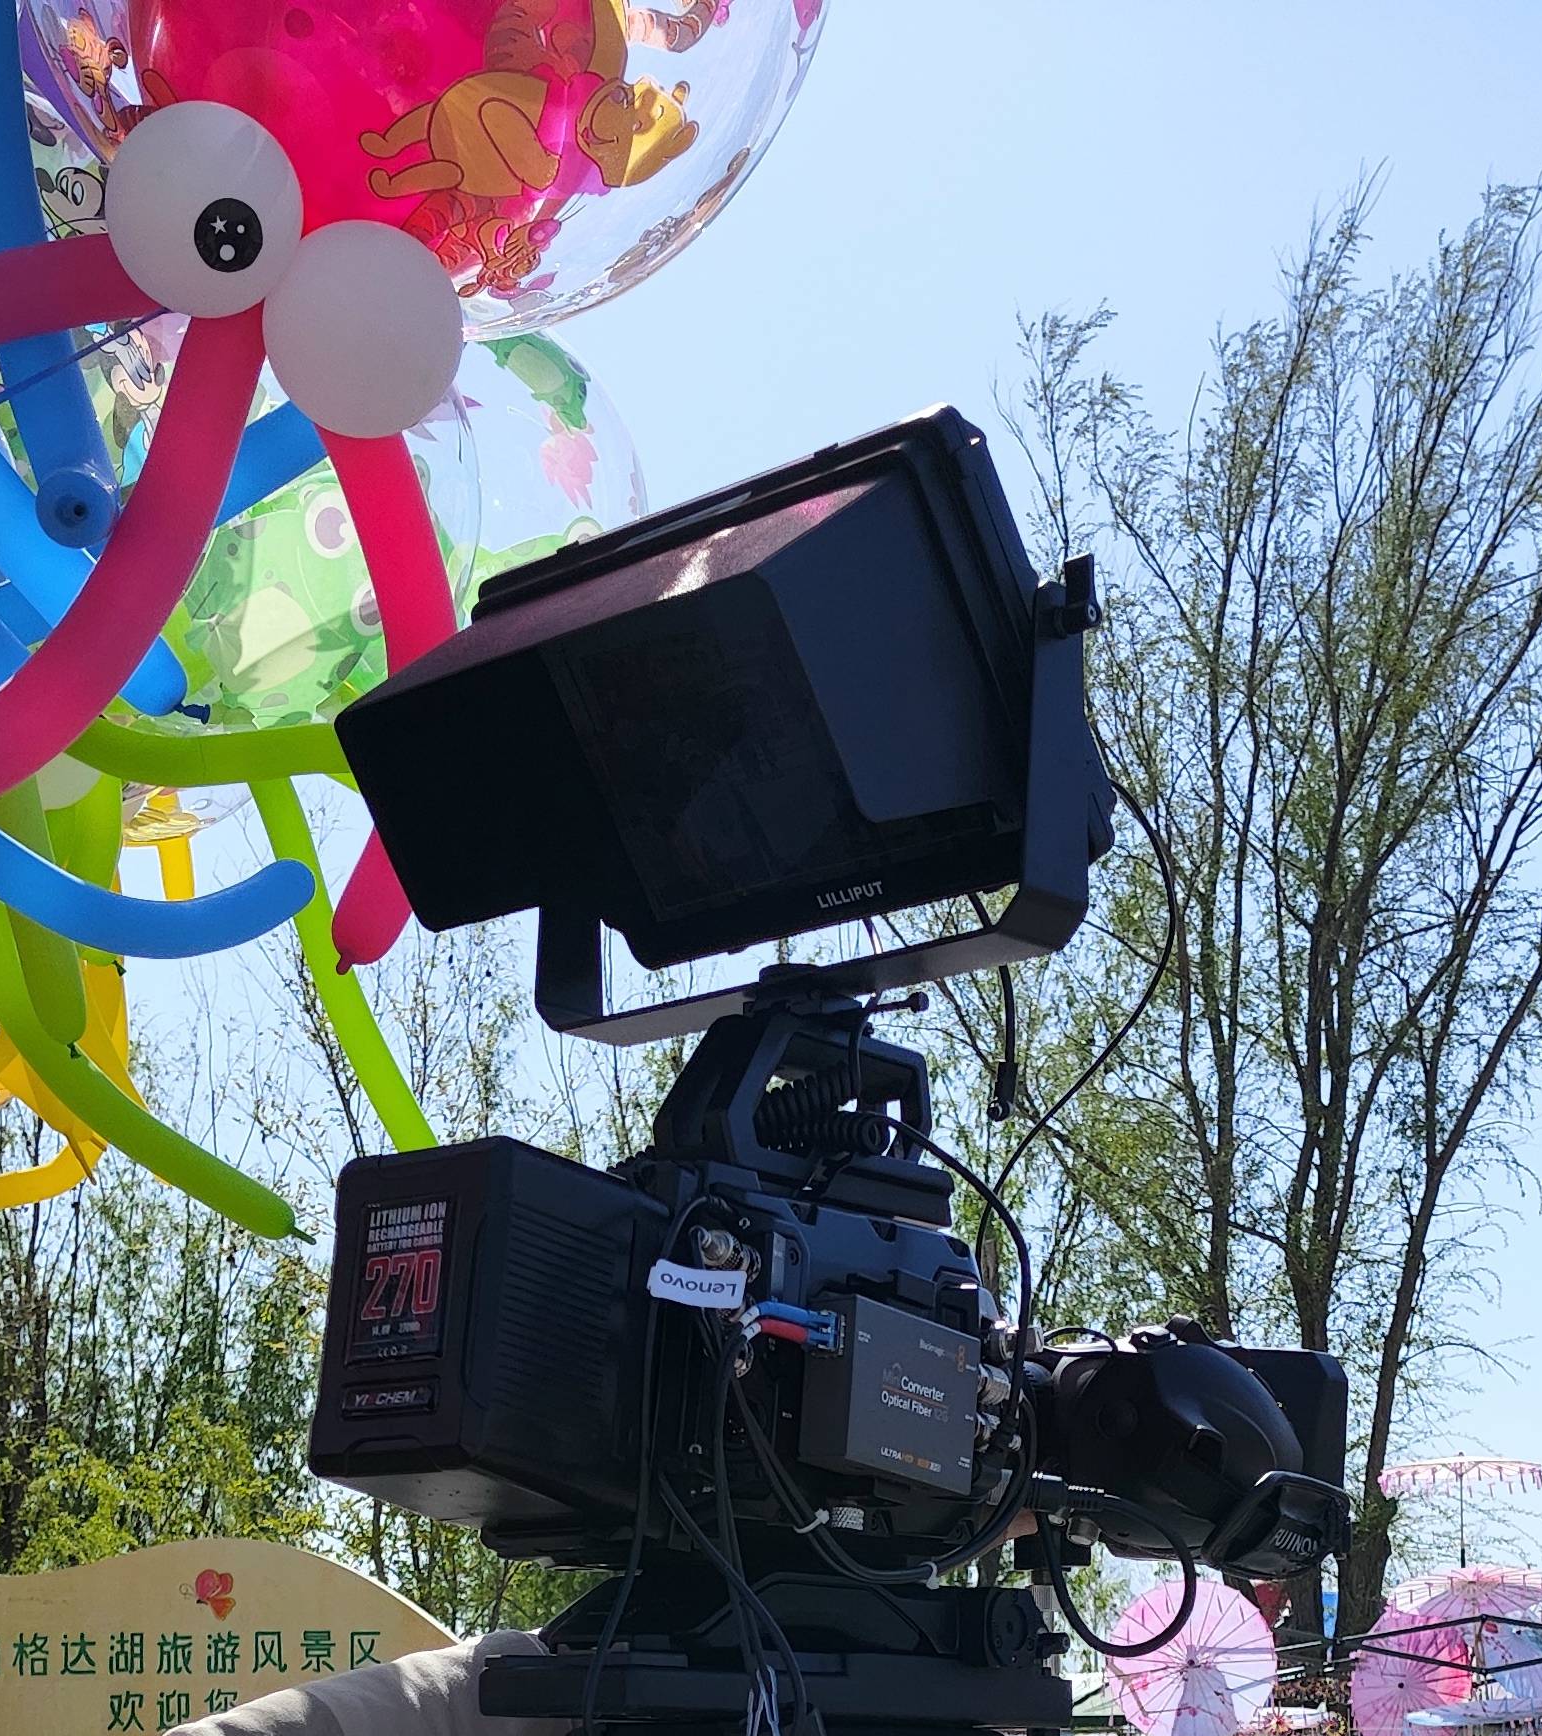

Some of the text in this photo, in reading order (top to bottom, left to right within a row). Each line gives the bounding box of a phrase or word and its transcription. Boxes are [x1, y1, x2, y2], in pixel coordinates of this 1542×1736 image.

[816, 880, 883, 908] LILLIPUT
[370, 1201, 447, 1228] LITHIUM ION
[368, 1219, 444, 1243] RECHARGEABLE
[361, 1249, 443, 1321] 270
[660, 1272, 737, 1297] Lenovo
[900, 1375, 945, 1402] Converter
[881, 1390, 910, 1411] Optical
[911, 1400, 933, 1418] Fiber
